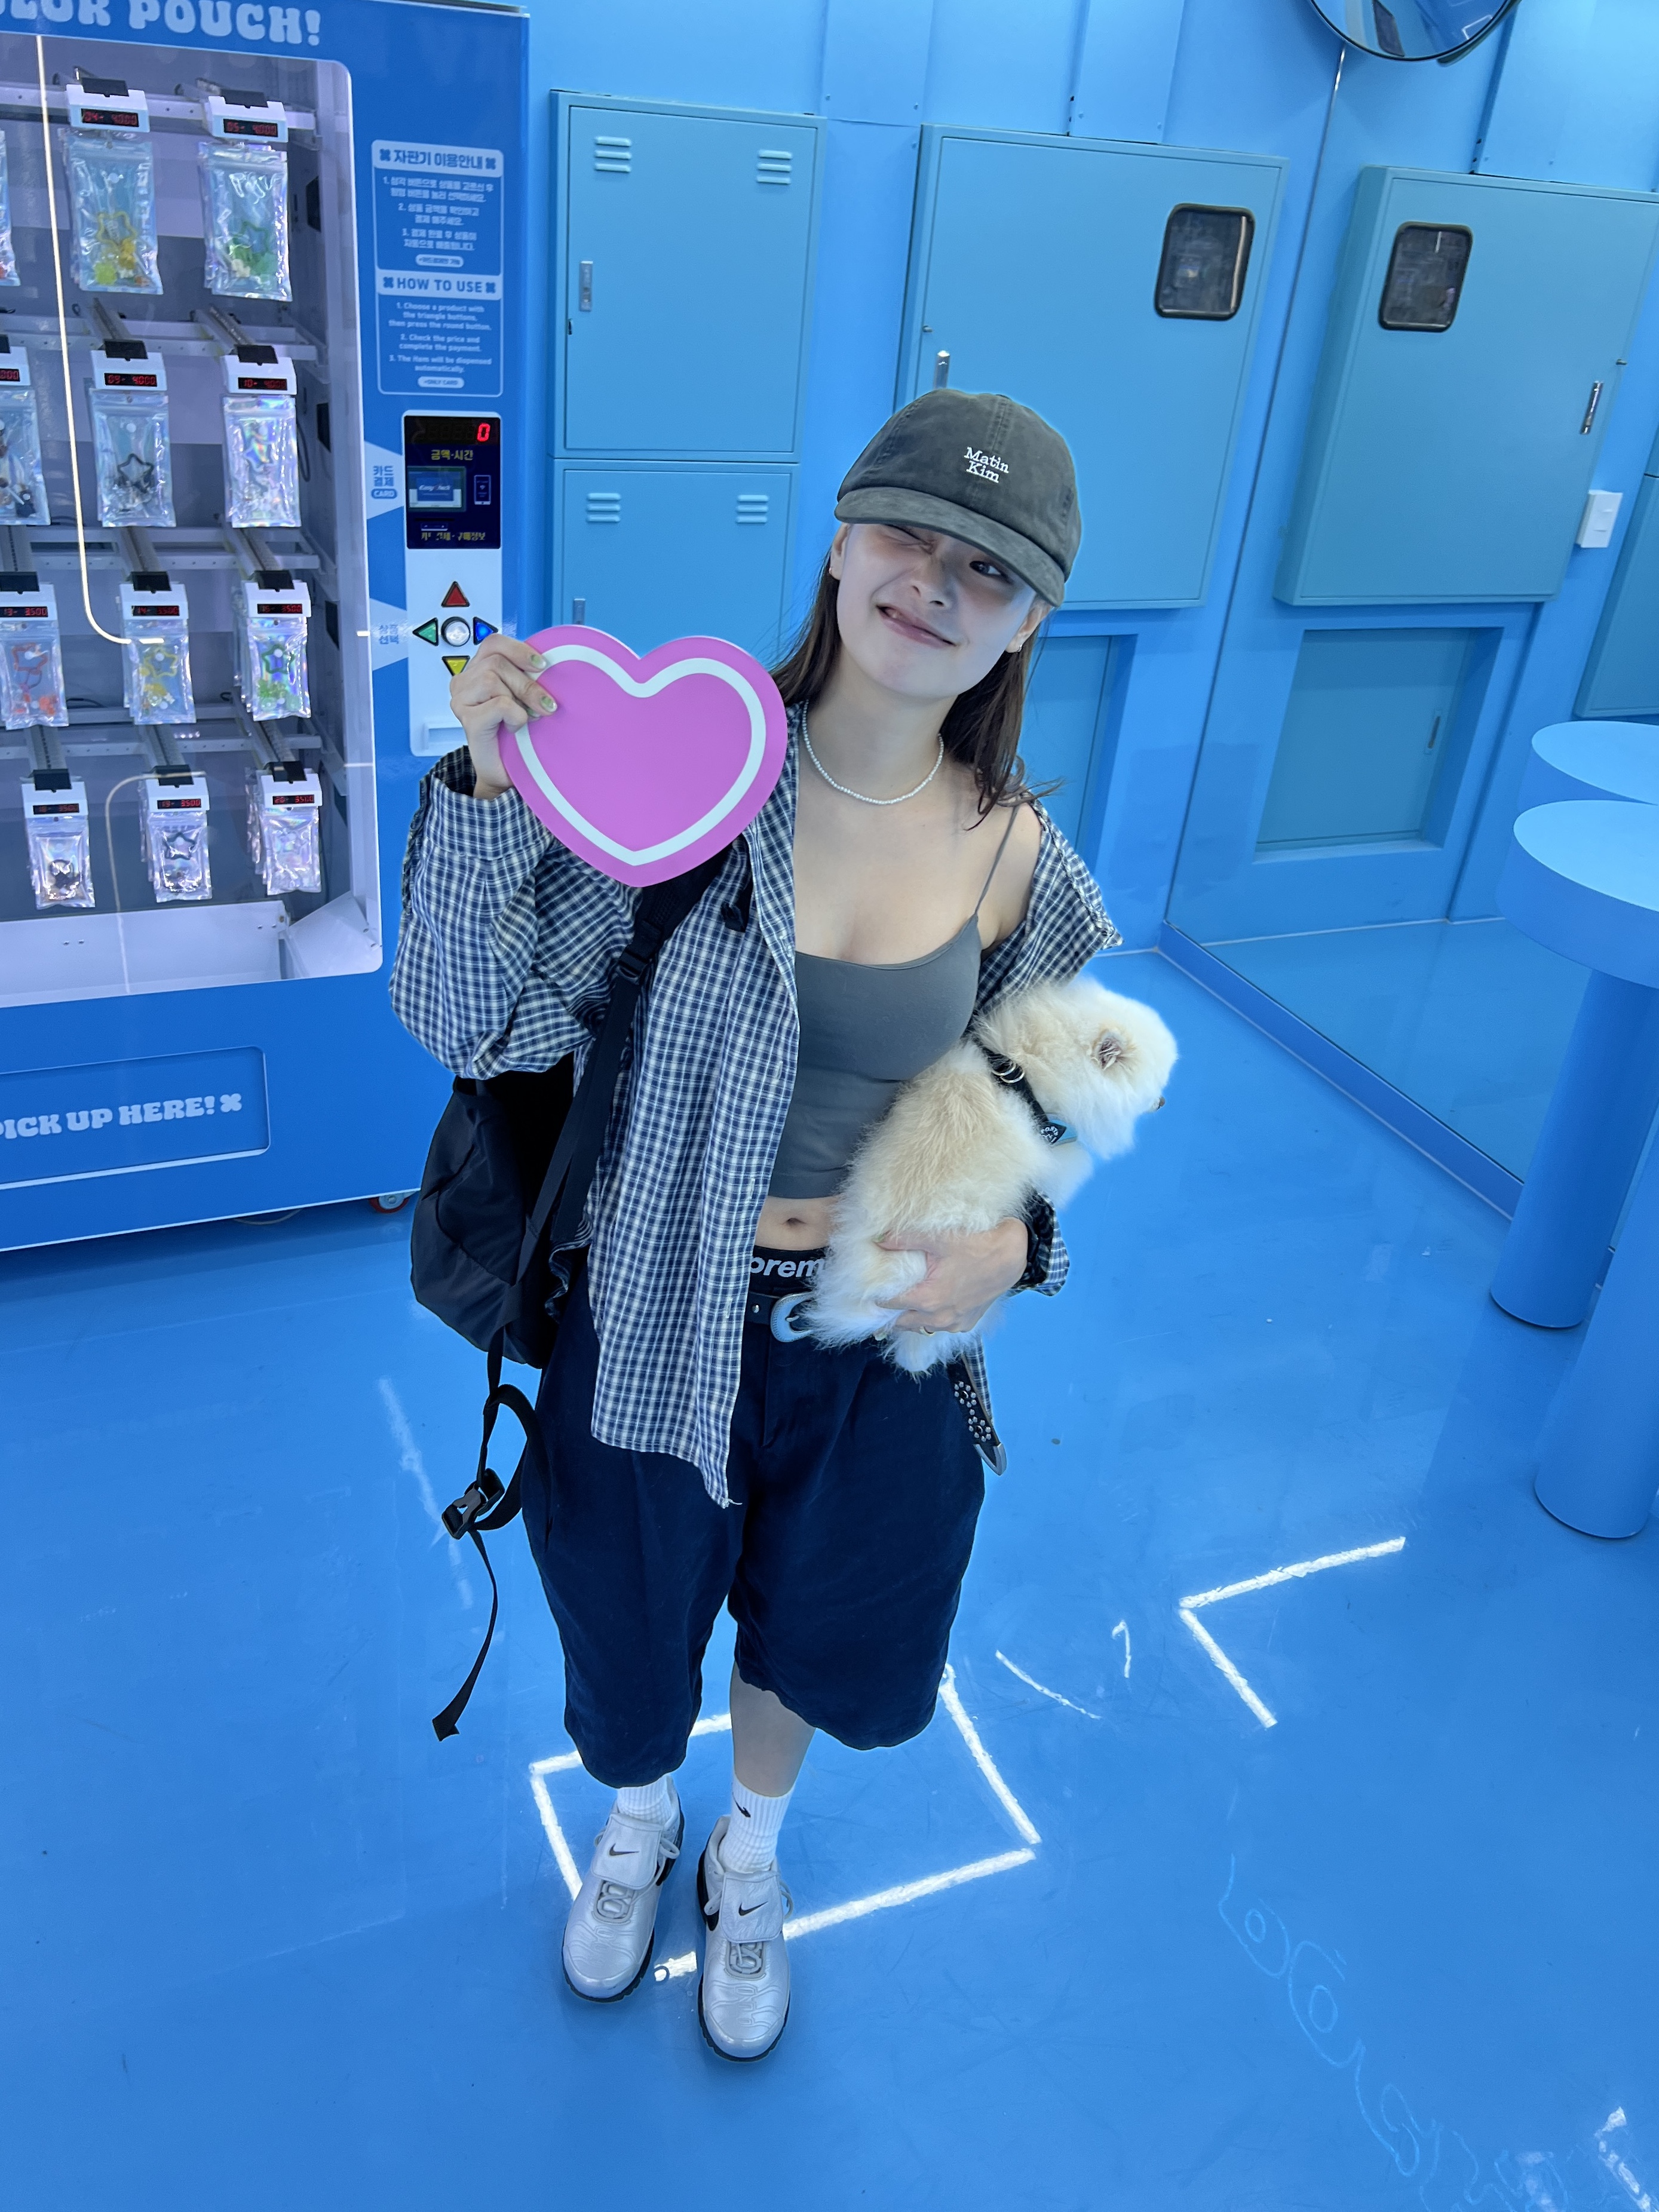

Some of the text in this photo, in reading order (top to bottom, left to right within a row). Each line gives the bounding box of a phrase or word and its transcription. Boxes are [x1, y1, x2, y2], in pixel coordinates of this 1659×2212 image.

[129, 0, 321, 46] POUCH!
[394, 149, 483, 170] 자판기 이용안내
[397, 278, 482, 293] HOW TO USE
[477, 423, 490, 442] 0
[964, 446, 1009, 473] Matin
[373, 465, 394, 476] 카드
[966, 461, 999, 483] Kim
[0, 1096, 215, 1139] ICK UP HERE!
